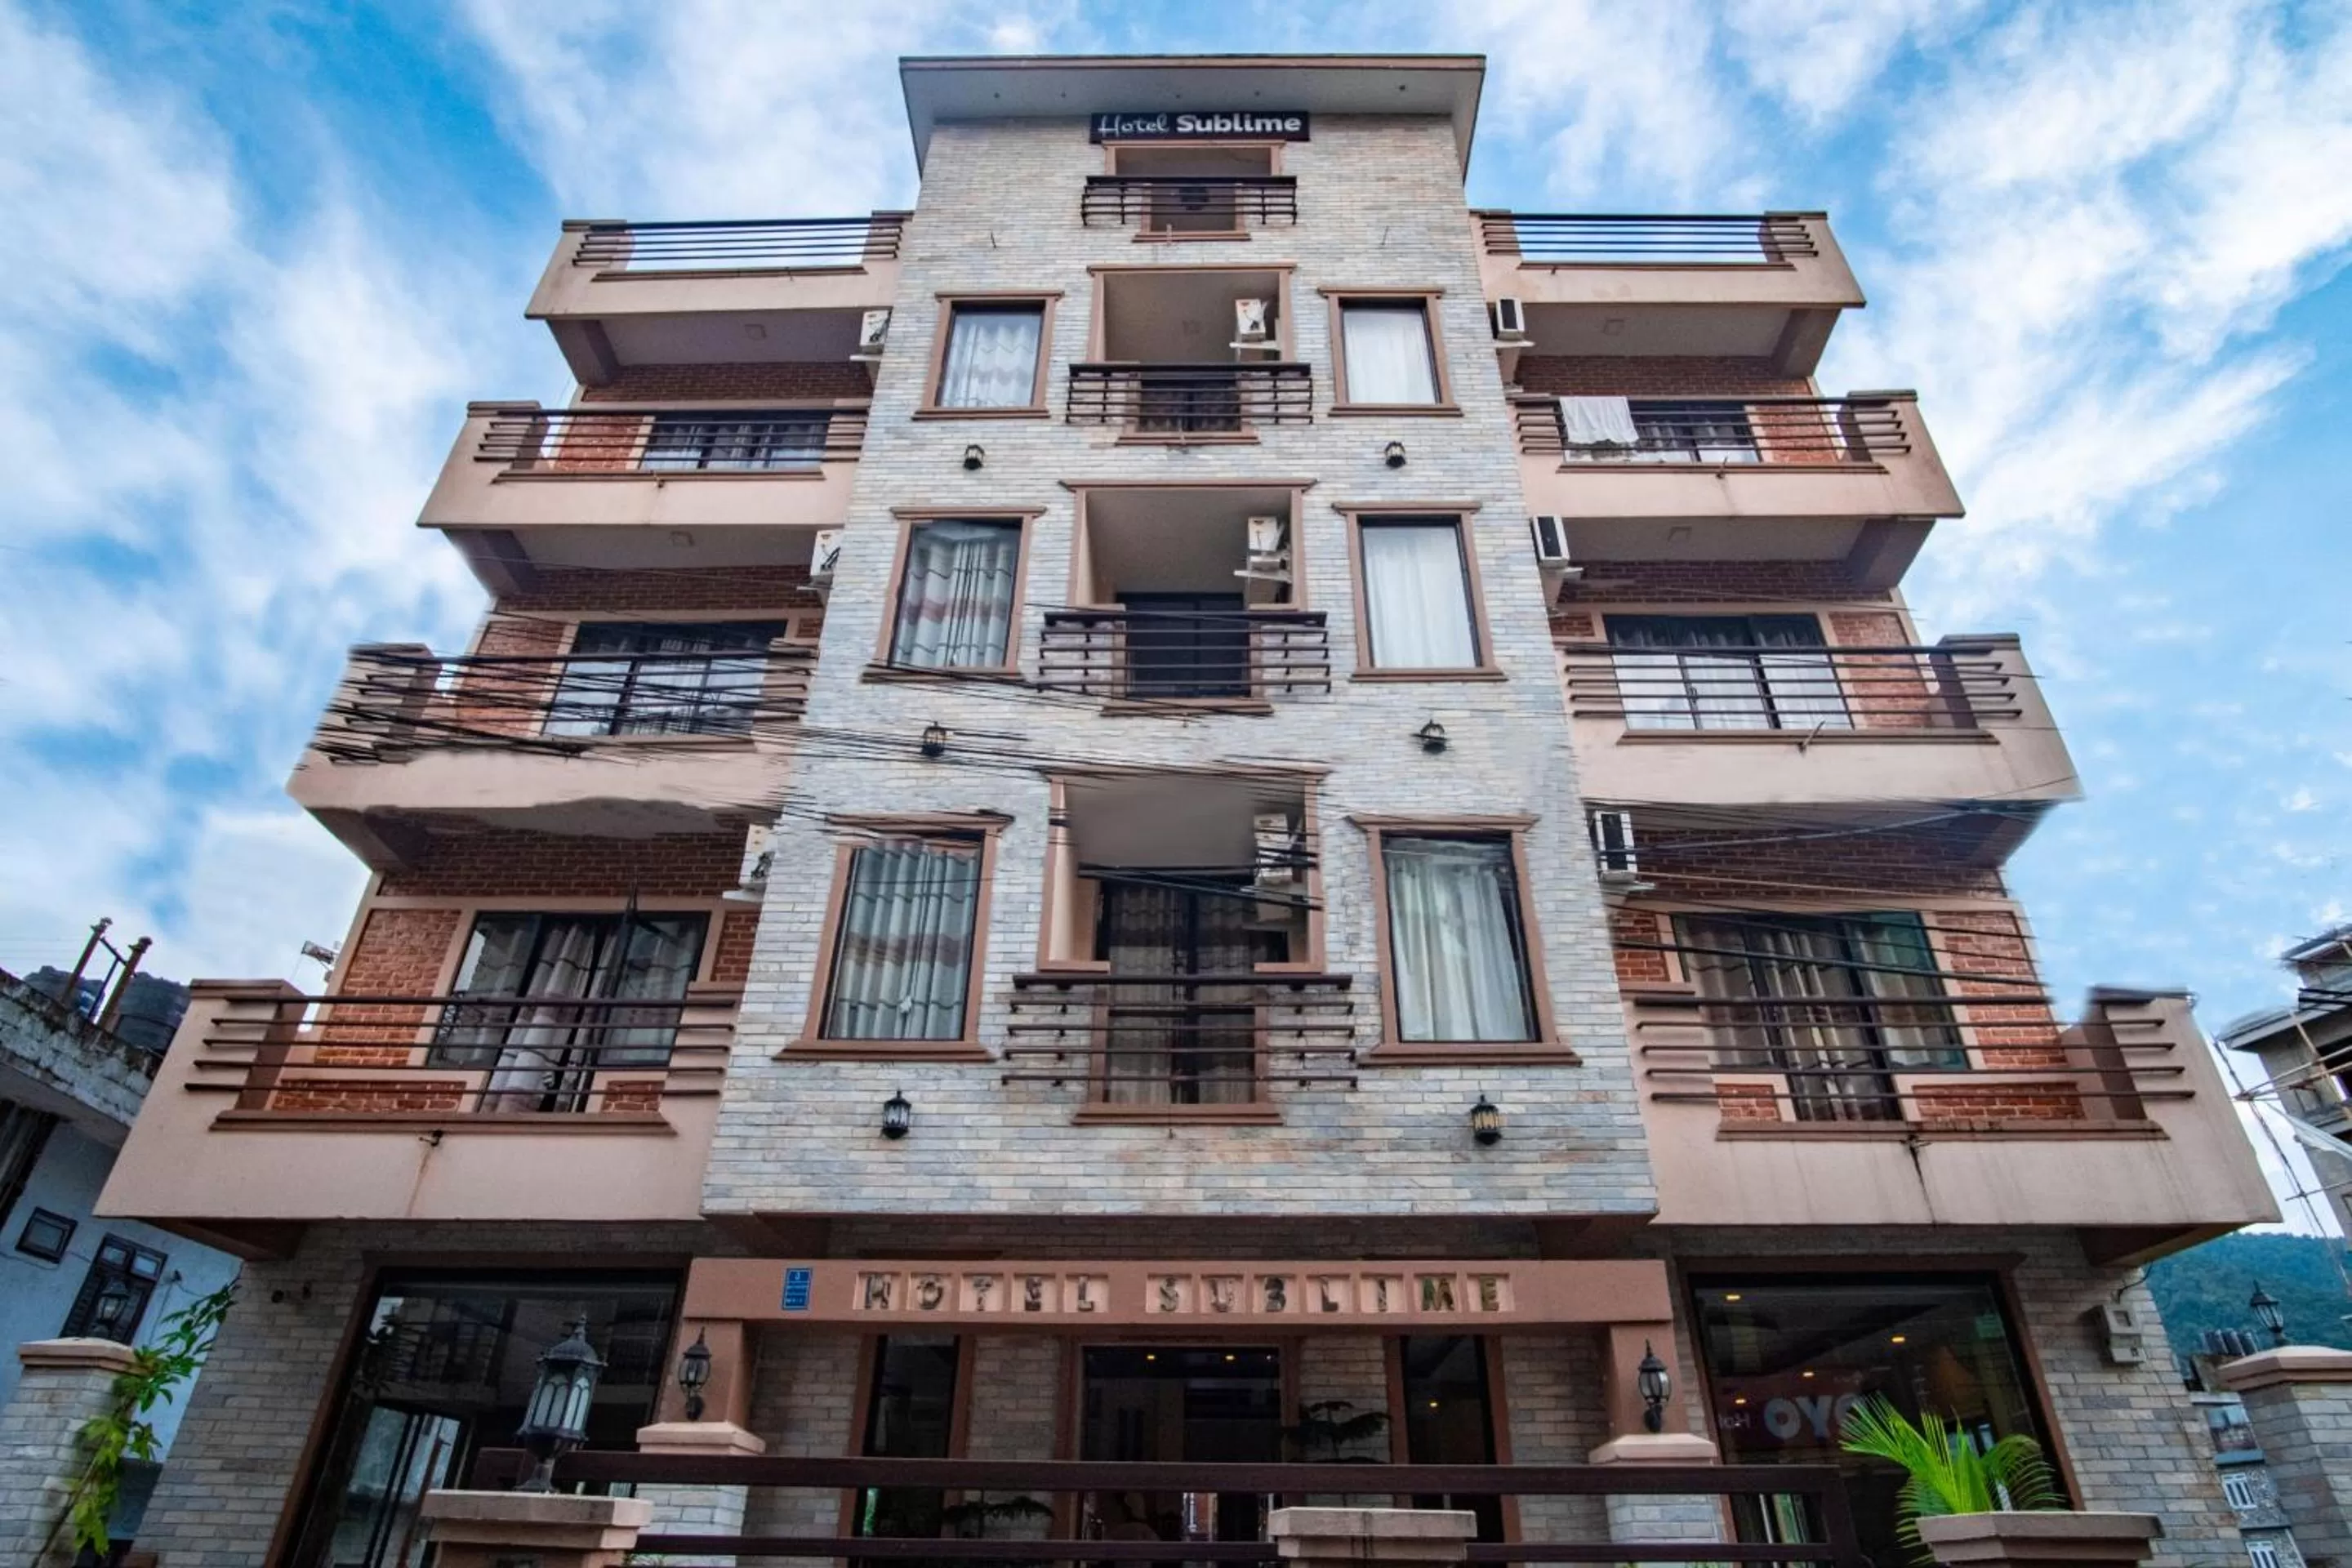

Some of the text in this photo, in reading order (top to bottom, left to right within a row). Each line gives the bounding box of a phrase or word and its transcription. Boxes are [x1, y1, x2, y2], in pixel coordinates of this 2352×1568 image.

[1098, 113, 1302, 137] Hotel Sublime
[865, 1273, 1500, 1312] HOTEL SUBLIME
